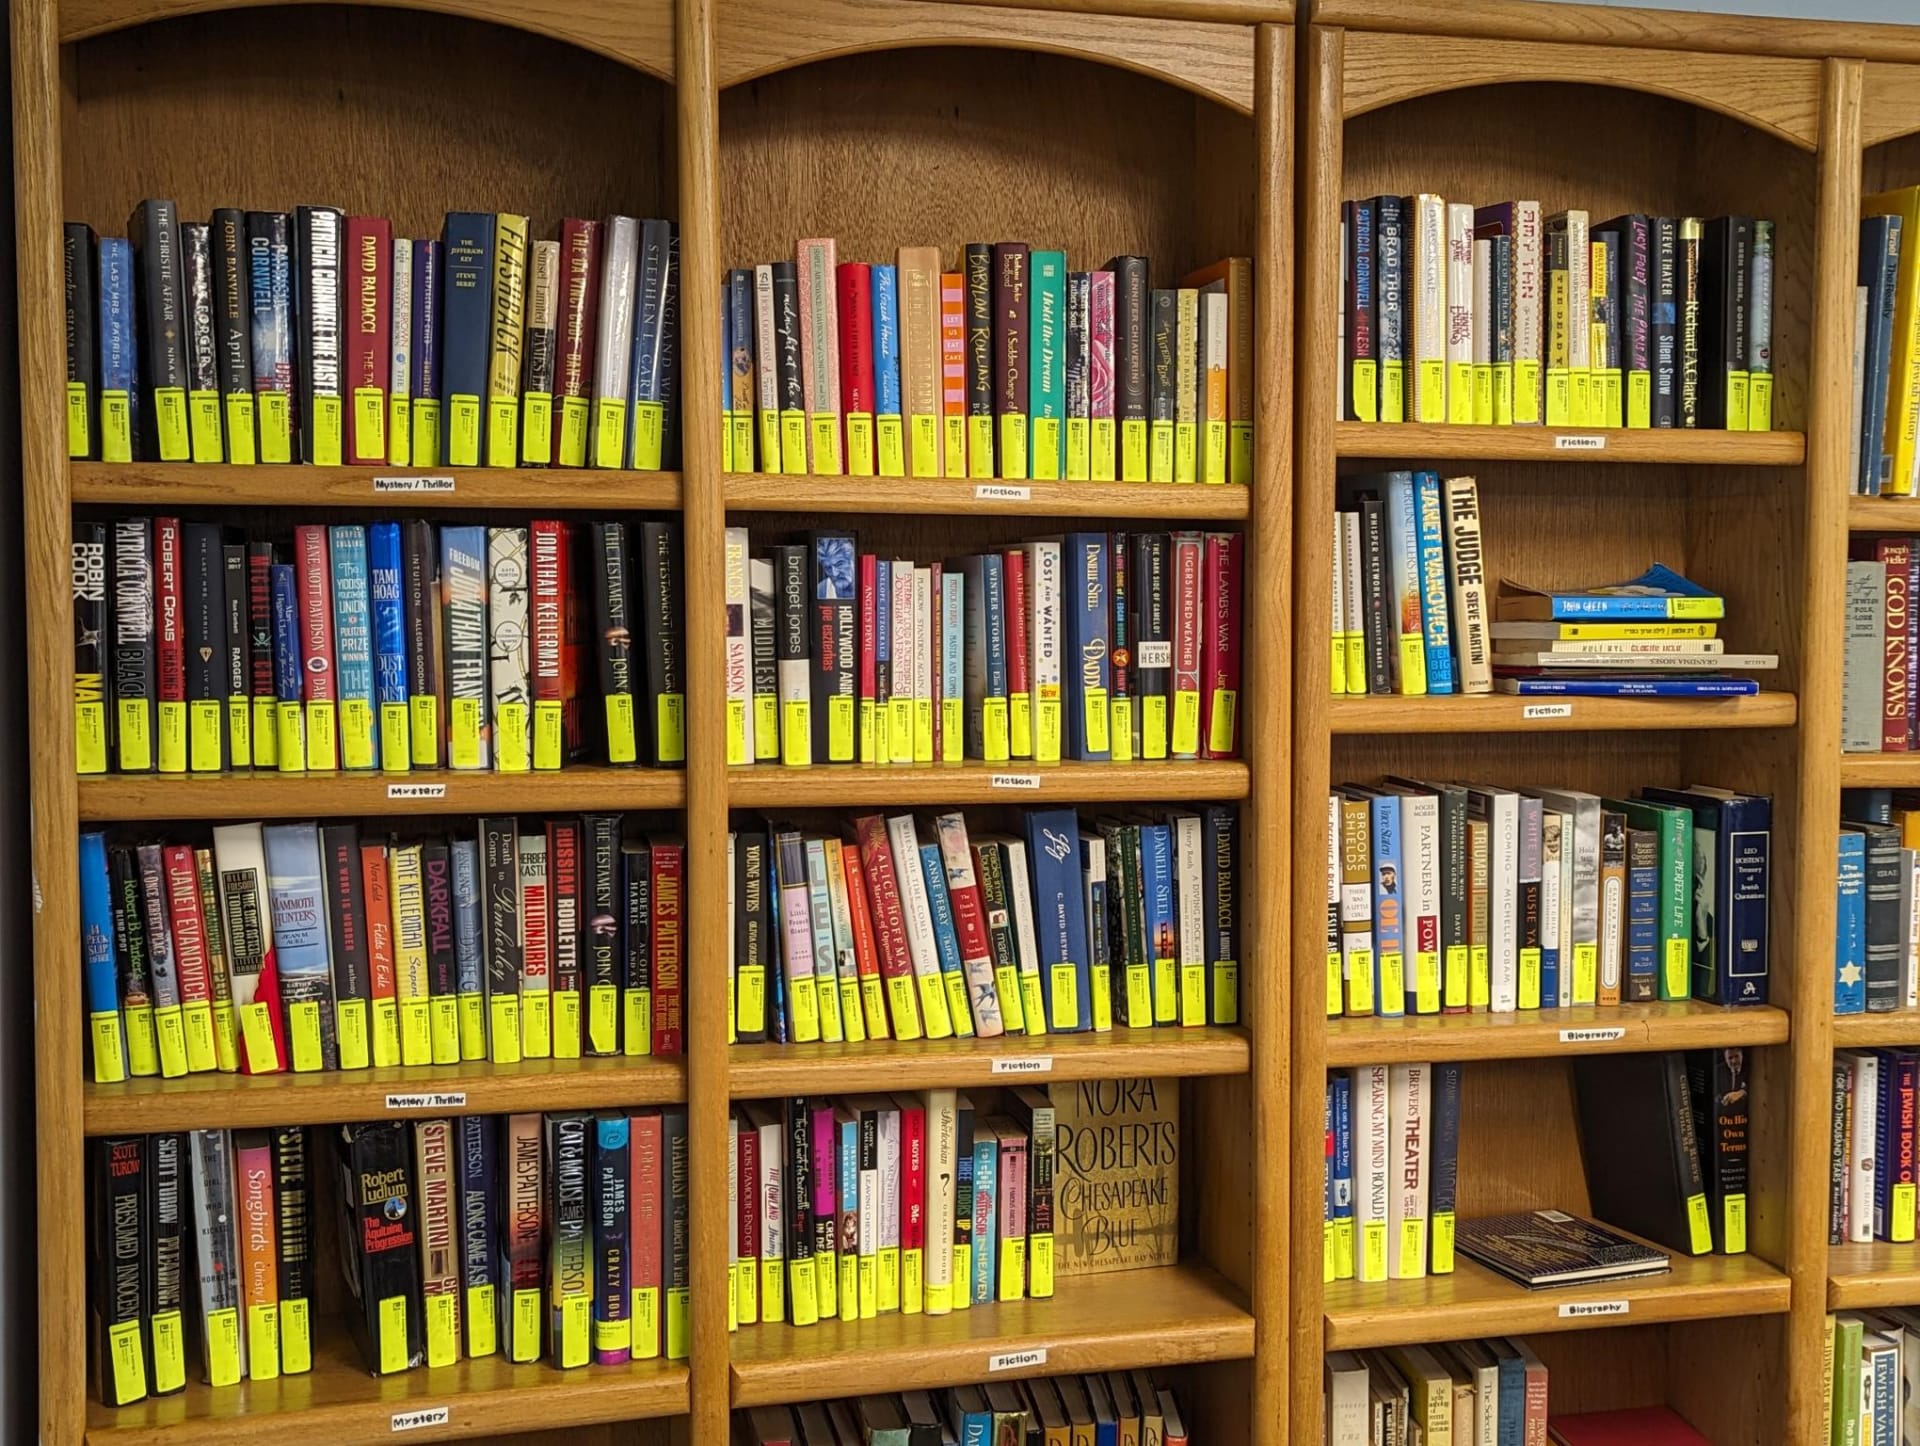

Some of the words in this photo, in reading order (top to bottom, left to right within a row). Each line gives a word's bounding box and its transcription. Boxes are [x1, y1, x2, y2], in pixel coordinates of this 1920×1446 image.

[158, 207, 168, 228] THE
[224, 220, 236, 252] JOHN
[1356, 208, 1370, 253] PATRICIA
[1632, 221, 1646, 250] LUCY
[159, 232, 171, 281] CHRISTIE
[311, 211, 337, 267] PATRICIA
[362, 236, 376, 271] DAVID
[1386, 226, 1396, 267] BRAD
[1662, 224, 1673, 255] STEVE
[1888, 228, 1899, 256] Israel
[111, 262, 120, 288] LAST
[226, 257, 239, 319] BANVILLE
[969, 254, 990, 320] BABYLON
[1356, 256, 1370, 310] CORNWELL
[1633, 253, 1646, 285] FOLEY
[1661, 259, 1673, 296] THAYER
[111, 292, 120, 316] MRS.
[162, 285, 173, 321] AFFAIR
[311, 269, 337, 332] CORNWELL
[361, 276, 376, 333] BALDACCI
[495, 225, 524, 362] FLASHBACK
[1042, 291, 1054, 323] Hold
[1131, 272, 1139, 321] JENNIFER
[1386, 272, 1397, 312] THOR
[1634, 294, 1645, 313] THE
[777, 294, 795, 350] midnight
[1043, 324, 1053, 347] the
[1356, 325, 1369, 356] FLESH
[1633, 317, 1648, 351] PARIS
[112, 322, 120, 367] PARRISH
[313, 336, 337, 357] THE
[786, 355, 795, 367] at
[971, 326, 990, 391] ROLLING
[1131, 324, 1140, 384] CHIAVERINI
[1659, 335, 1673, 364] Silent
[313, 359, 338, 387] LAST
[787, 377, 797, 397] the
[1042, 348, 1054, 393] Dream
[1659, 368, 1673, 396] Snow
[1561, 439, 1597, 447] Fiction
[376, 480, 412, 491] Mystery
[983, 488, 1021, 496] Fiction
[1451, 486, 1477, 520] THE
[1370, 513, 1378, 552] WHISPER
[1421, 486, 1440, 542] JANET
[116, 523, 146, 578] PATRICIA
[162, 527, 174, 592] ROBERT
[306, 533, 320, 564] DIANE
[605, 531, 619, 552] THE
[1454, 526, 1482, 587] JUDGE
[72, 542, 88, 601] COOK
[88, 543, 104, 601] ROBIN
[308, 568, 322, 598] MOTT
[372, 570, 399, 585] TAMI
[412, 554, 421, 606] INTUITION
[536, 531, 558, 596] JONATHAN
[786, 556, 803, 609] bridget
[1043, 551, 1052, 582] LOST
[1086, 544, 1100, 583] DANIELLE
[1185, 551, 1194, 585] TIGERS
[1372, 556, 1380, 598] NETWORK
[373, 585, 399, 600] HOAG
[606, 555, 624, 619] TESTAMENT
[989, 568, 998, 610] WINTER
[1088, 583, 1103, 611] STEEL
[1185, 587, 1194, 598] IN
[1424, 547, 1448, 647] EVANOVICH
[1465, 591, 1479, 621] STEVE
[1886, 576, 1906, 630] GOD
[117, 581, 147, 644] CORNWELL
[164, 596, 175, 641] CRAIS
[310, 600, 325, 651] DAVIDSON
[449, 566, 480, 651] JONATHAN
[819, 606, 833, 621] joe
[1184, 600, 1194, 619] RED
[537, 602, 559, 677] KELLERMAN
[786, 613, 802, 654] jones
[822, 625, 835, 671] eszterhas
[839, 606, 854, 669] HOLLYWOOD
[991, 614, 1000, 658] STORMS
[1043, 606, 1052, 658] WANTED
[1183, 621, 1194, 665] WEATHER
[1468, 623, 1483, 665] MARTINI
[1886, 635, 1906, 717] KNOWS
[1528, 707, 1564, 716] Fiction
[391, 788, 443, 796] Mystery
[994, 777, 1032, 785] Fiction
[556, 828, 574, 895] RUSSIAN
[746, 845, 760, 878] YOUNG
[1154, 831, 1169, 879] DANIELLE
[1216, 833, 1231, 868] DAVID
[1345, 812, 1356, 872] SHIELDS
[1356, 812, 1367, 872] BROOKE
[1420, 825, 1432, 897] PARTNERS
[1472, 829, 1486, 886] TRIUMPH
[397, 852, 419, 880] FAYE
[927, 859, 944, 890] ANNE
[123, 879, 143, 920] Robert
[170, 867, 197, 912] JANET
[427, 859, 449, 955] DARKFALL
[630, 882, 638, 926] HARRIS
[639, 880, 647, 926] ROBERT
[656, 873, 678, 916] JAMES
[746, 880, 760, 912] WIVES
[935, 893, 949, 926] PERRY
[1156, 885, 1170, 916] STEEL
[1217, 872, 1232, 928] BALDACCI
[1423, 899, 1433, 912] in
[398, 883, 423, 949] KELLERMAN
[523, 885, 547, 977] MILLIONAIRES
[558, 898, 576, 967] ROULETTE
[129, 937, 145, 980] Parker's
[176, 918, 208, 1002] EVANOVICH
[656, 920, 679, 990] PATTERSON
[1567, 1031, 1619, 1040] Biography
[389, 1097, 424, 1107] Mystery
[1077, 1077, 1158, 1119] NORA
[1371, 1067, 1384, 1120] SPEAKING
[1900, 1087, 1913, 1129] JEWISH
[424, 1127, 445, 1175] STEVE
[1055, 1121, 1176, 1183] ROBERTS
[1372, 1122, 1384, 1140] MY
[1900, 1132, 1913, 1168] BOOK
[158, 1138, 178, 1177] SCOTT
[516, 1136, 538, 1172] JAMES
[1371, 1140, 1384, 1168] MIND
[1404, 1118, 1420, 1190] THEATER
[361, 1169, 405, 1186] Robert
[603, 1167, 614, 1226] PATTERSON
[615, 1178, 624, 1213] JAMES
[158, 1181, 178, 1224] TUROW
[246, 1170, 267, 1252] Songbirds
[425, 1180, 449, 1248] MARTINI
[466, 1190, 486, 1229] ALONG
[516, 1174, 538, 1240] PATTERSON
[1060, 1177, 1168, 1221] CHESAPEAKE
[115, 1194, 138, 1259] PRESUMED
[466, 1230, 487, 1265] CAME
[1081, 1215, 1138, 1256] BLUE
[254, 1261, 265, 1296] Christy
[1569, 1304, 1621, 1314] Biography
[999, 1355, 1037, 1366] Fiction
[393, 1413, 445, 1427] Mystery
